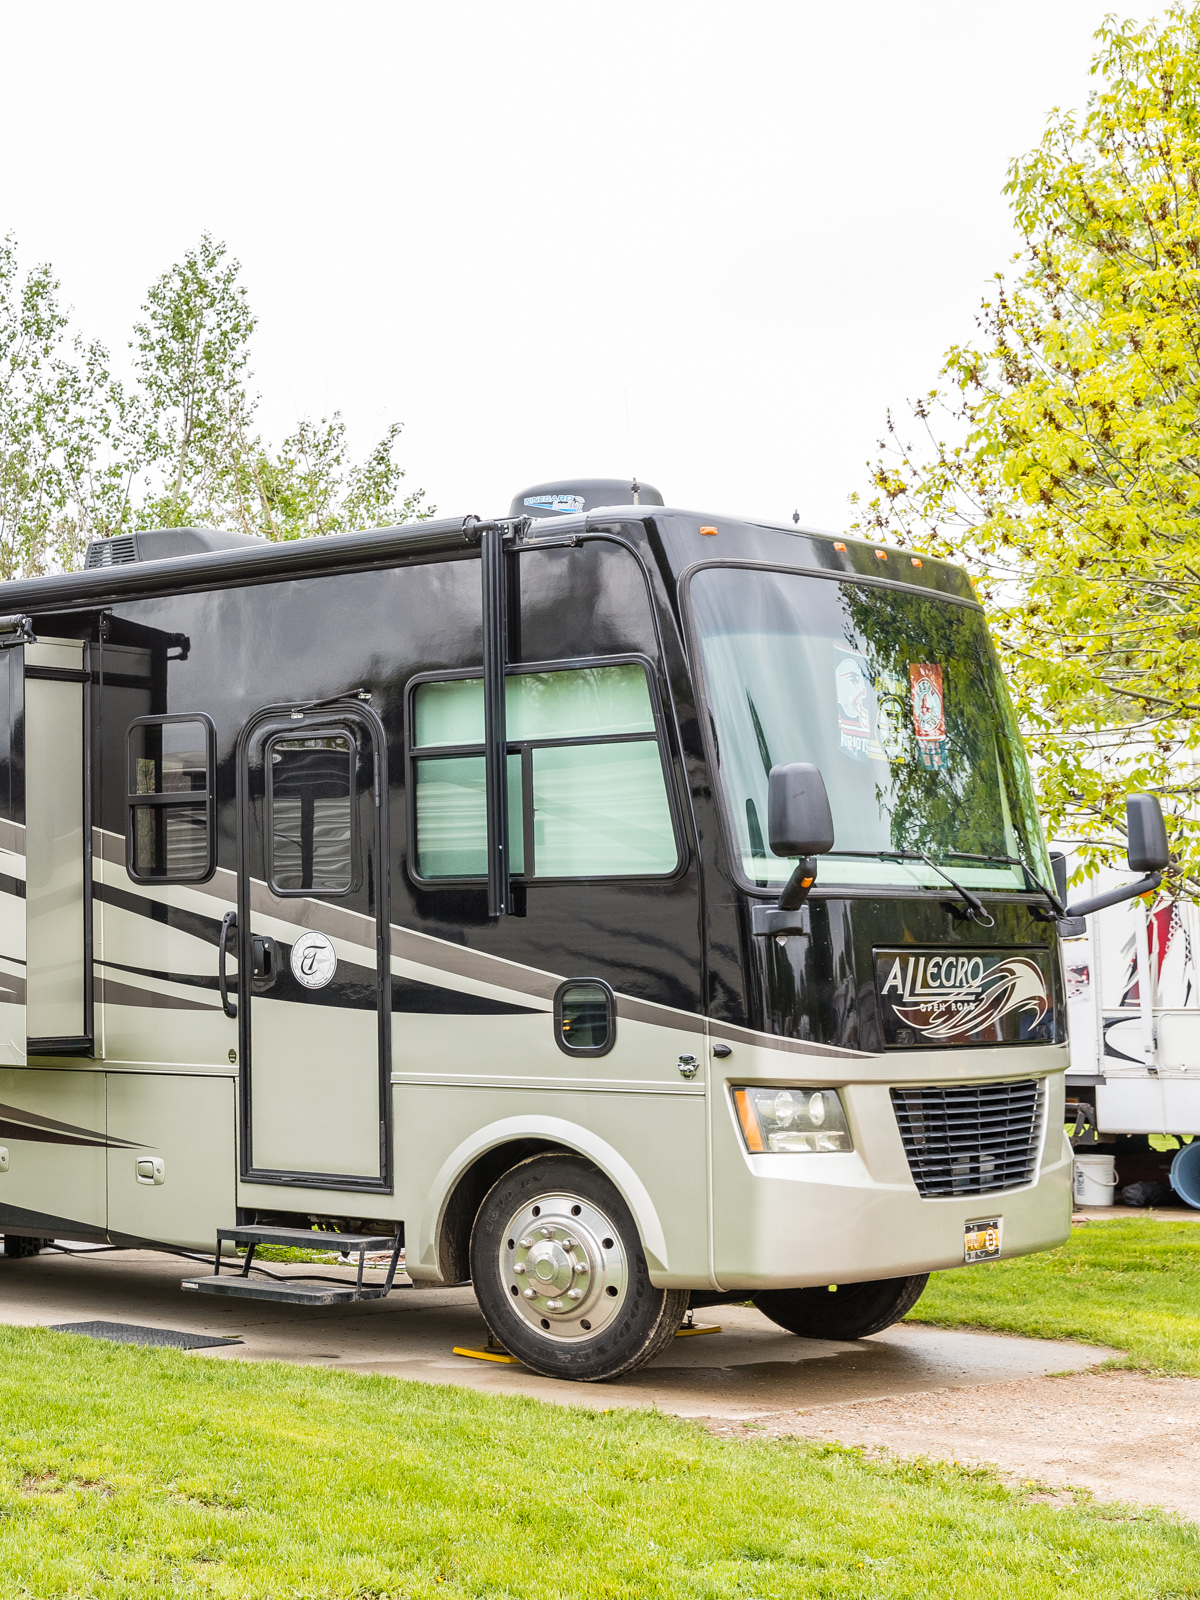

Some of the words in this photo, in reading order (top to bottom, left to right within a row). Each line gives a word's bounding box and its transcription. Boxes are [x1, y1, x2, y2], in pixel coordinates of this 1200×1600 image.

[881, 956, 984, 1002] ALLEGRO
[919, 1003, 946, 1012] OPEN
[951, 1002, 976, 1012] ROAD
